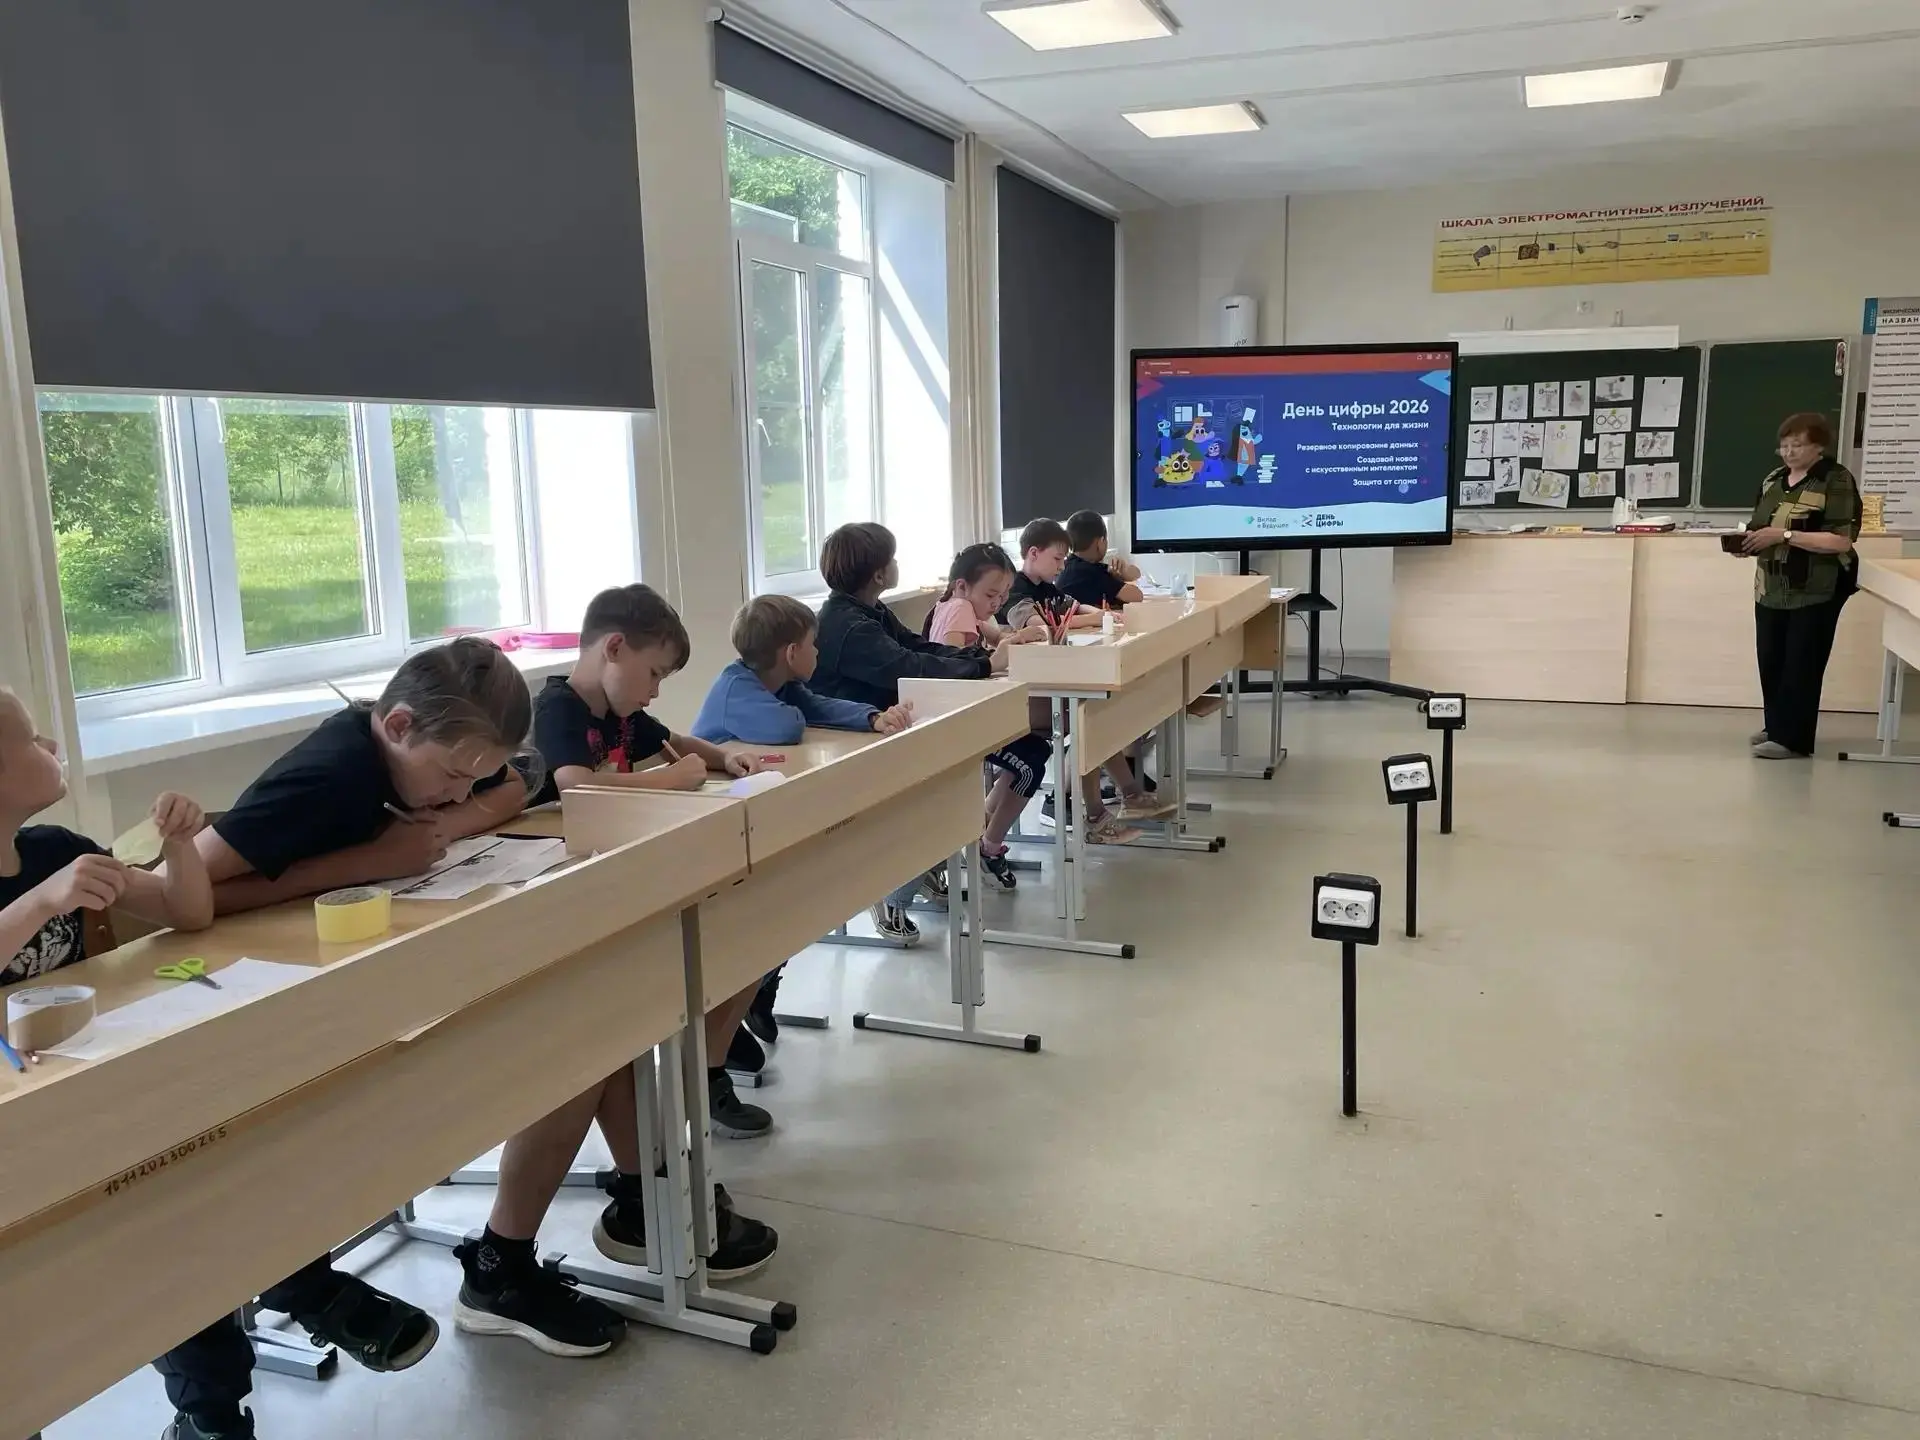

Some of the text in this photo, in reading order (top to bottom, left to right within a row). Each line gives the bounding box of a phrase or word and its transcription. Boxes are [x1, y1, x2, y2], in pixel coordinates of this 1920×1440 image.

[1441, 217, 1494, 229] ШКАЛА
[1497, 205, 1664, 225] ЭЛЕКТРОМАГНИТНЫХ
[1668, 196, 1764, 213] ИЗЛУЧЕНИЙ
[1282, 399, 1430, 420] День цифры 2026
[1332, 421, 1429, 432] Технологии для жизни
[1296, 440, 1419, 453] Резервное копирование данных
[1369, 464, 1418, 473] интеллектом
[1352, 478, 1383, 487] Защита
[1383, 478, 1393, 486] от
[1315, 513, 1336, 521] ДЕНЬ
[1315, 520, 1344, 528] ЦИФРЫ
